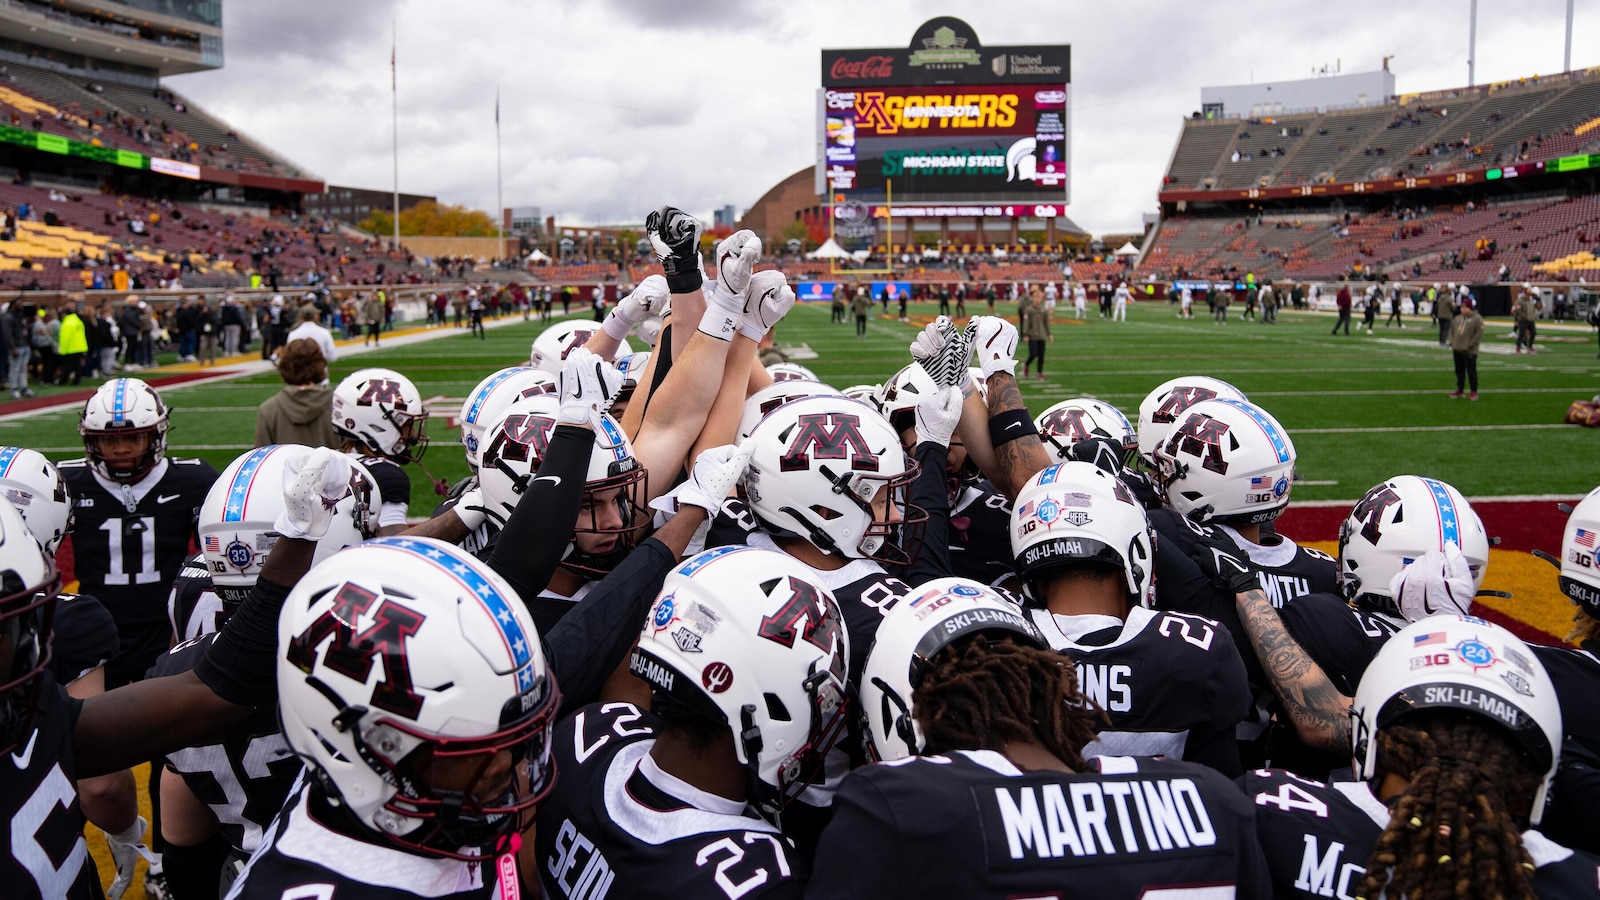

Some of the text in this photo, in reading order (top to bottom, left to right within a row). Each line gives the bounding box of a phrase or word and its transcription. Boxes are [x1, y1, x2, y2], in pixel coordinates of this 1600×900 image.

[1010, 55, 1042, 65] United
[1010, 65, 1062, 75] Healthcare
[825, 91, 856, 101] Great
[884, 94, 1019, 128] GOPHERS
[903, 105, 981, 118] MINNESOTA
[902, 155, 1005, 168] MICHIGAN STATE
[1035, 205, 1057, 217] Cub
[780, 413, 879, 472] M
[98, 517, 162, 586] 11
[231, 549, 248, 562] 33
[1025, 541, 1082, 564] SKI-U-MAH
[656, 604, 673, 621] 27
[286, 581, 427, 721] M
[1464, 645, 1488, 661] 24
[1424, 687, 1520, 726] SKI-U-MAH
[995, 778, 1217, 860] MARTINO
[695, 831, 791, 900] 27
